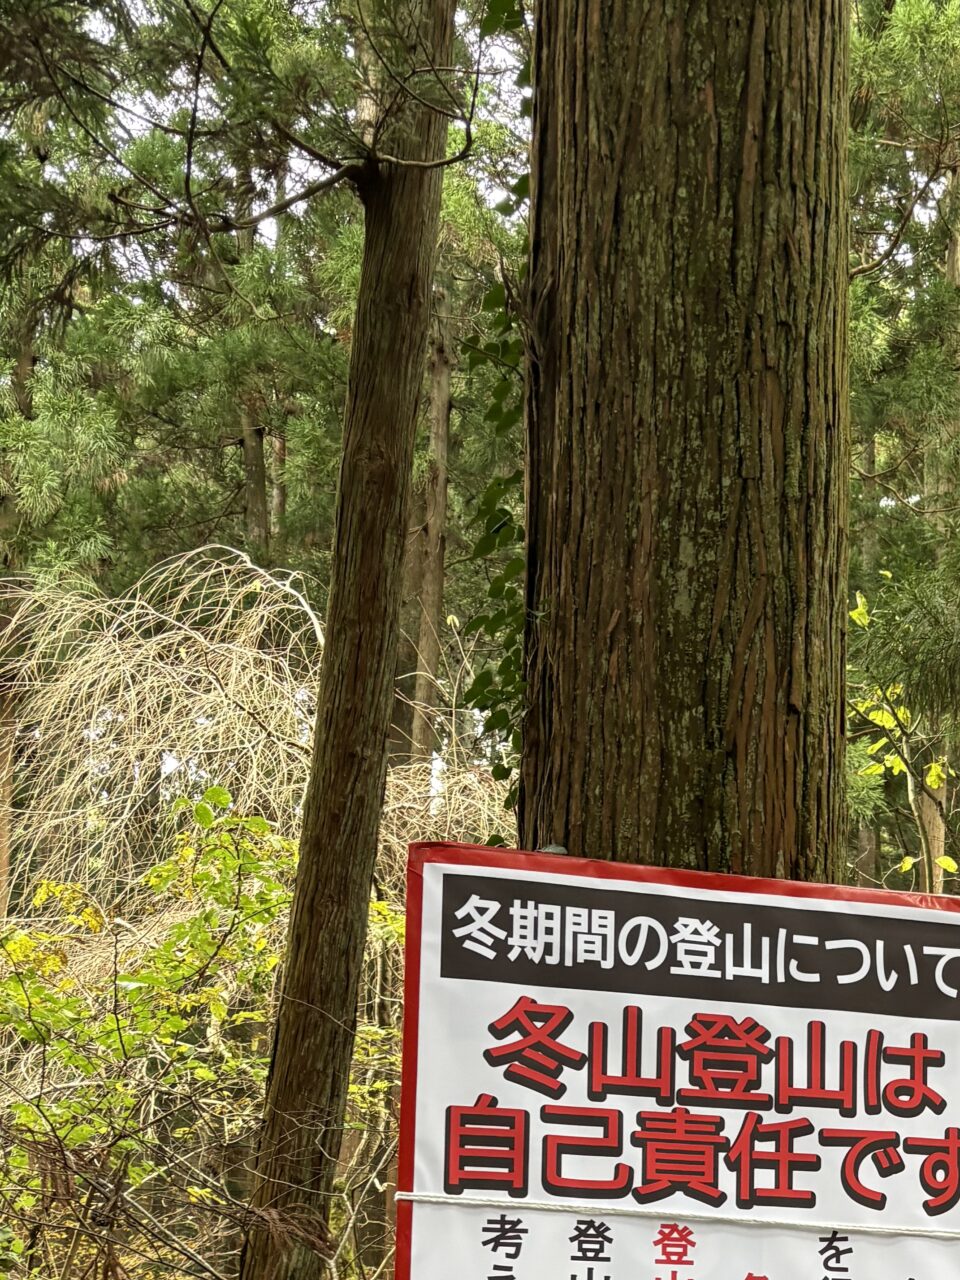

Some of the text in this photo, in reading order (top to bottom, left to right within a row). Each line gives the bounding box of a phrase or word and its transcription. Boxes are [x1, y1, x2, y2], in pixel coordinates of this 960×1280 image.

[483, 995, 947, 1117] 冬山登山は
